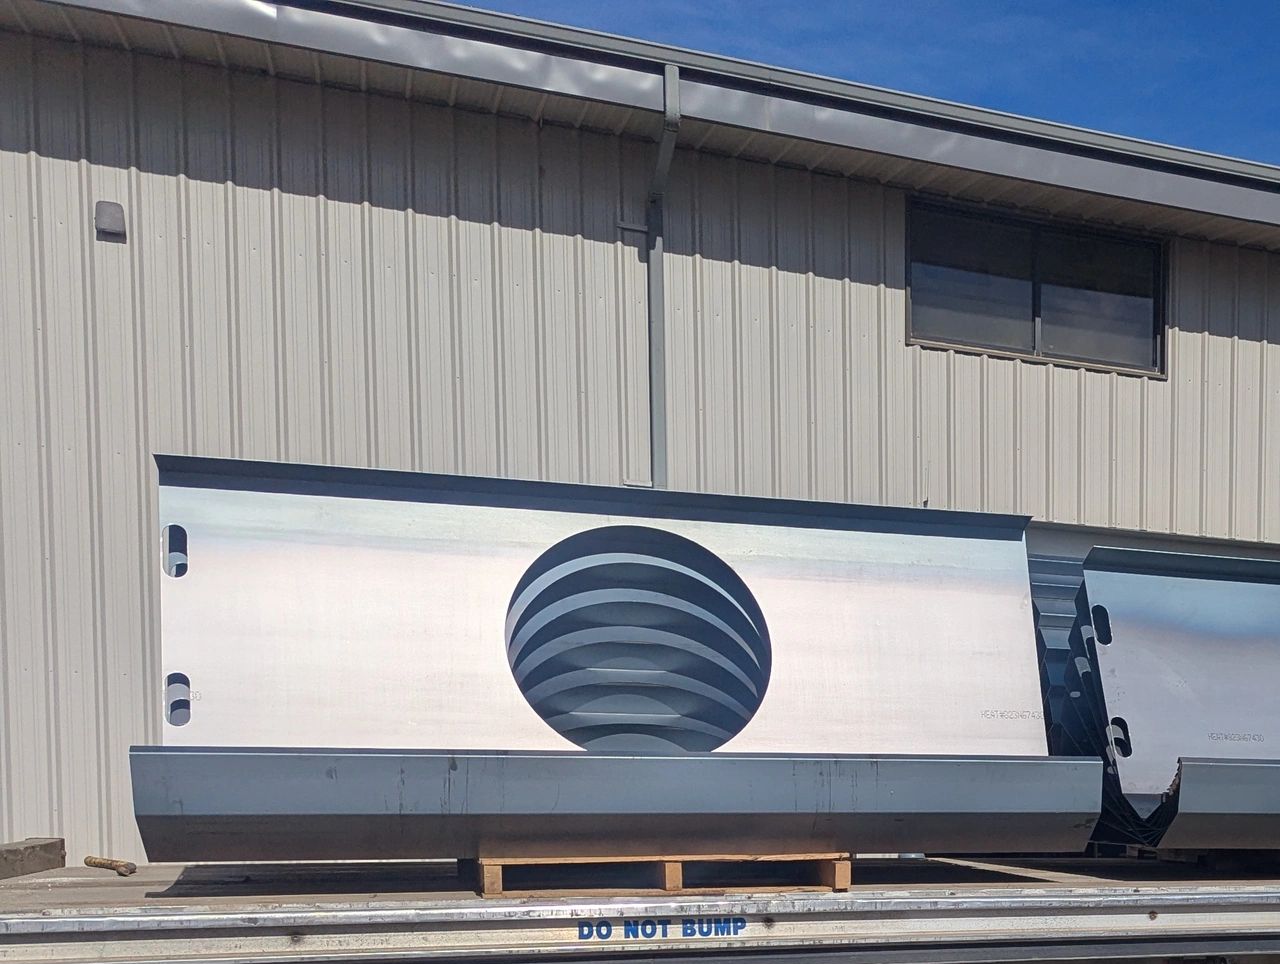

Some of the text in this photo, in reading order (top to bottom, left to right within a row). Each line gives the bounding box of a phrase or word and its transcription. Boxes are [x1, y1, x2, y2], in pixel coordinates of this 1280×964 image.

[578, 917, 747, 940] DO NOT BUMP
